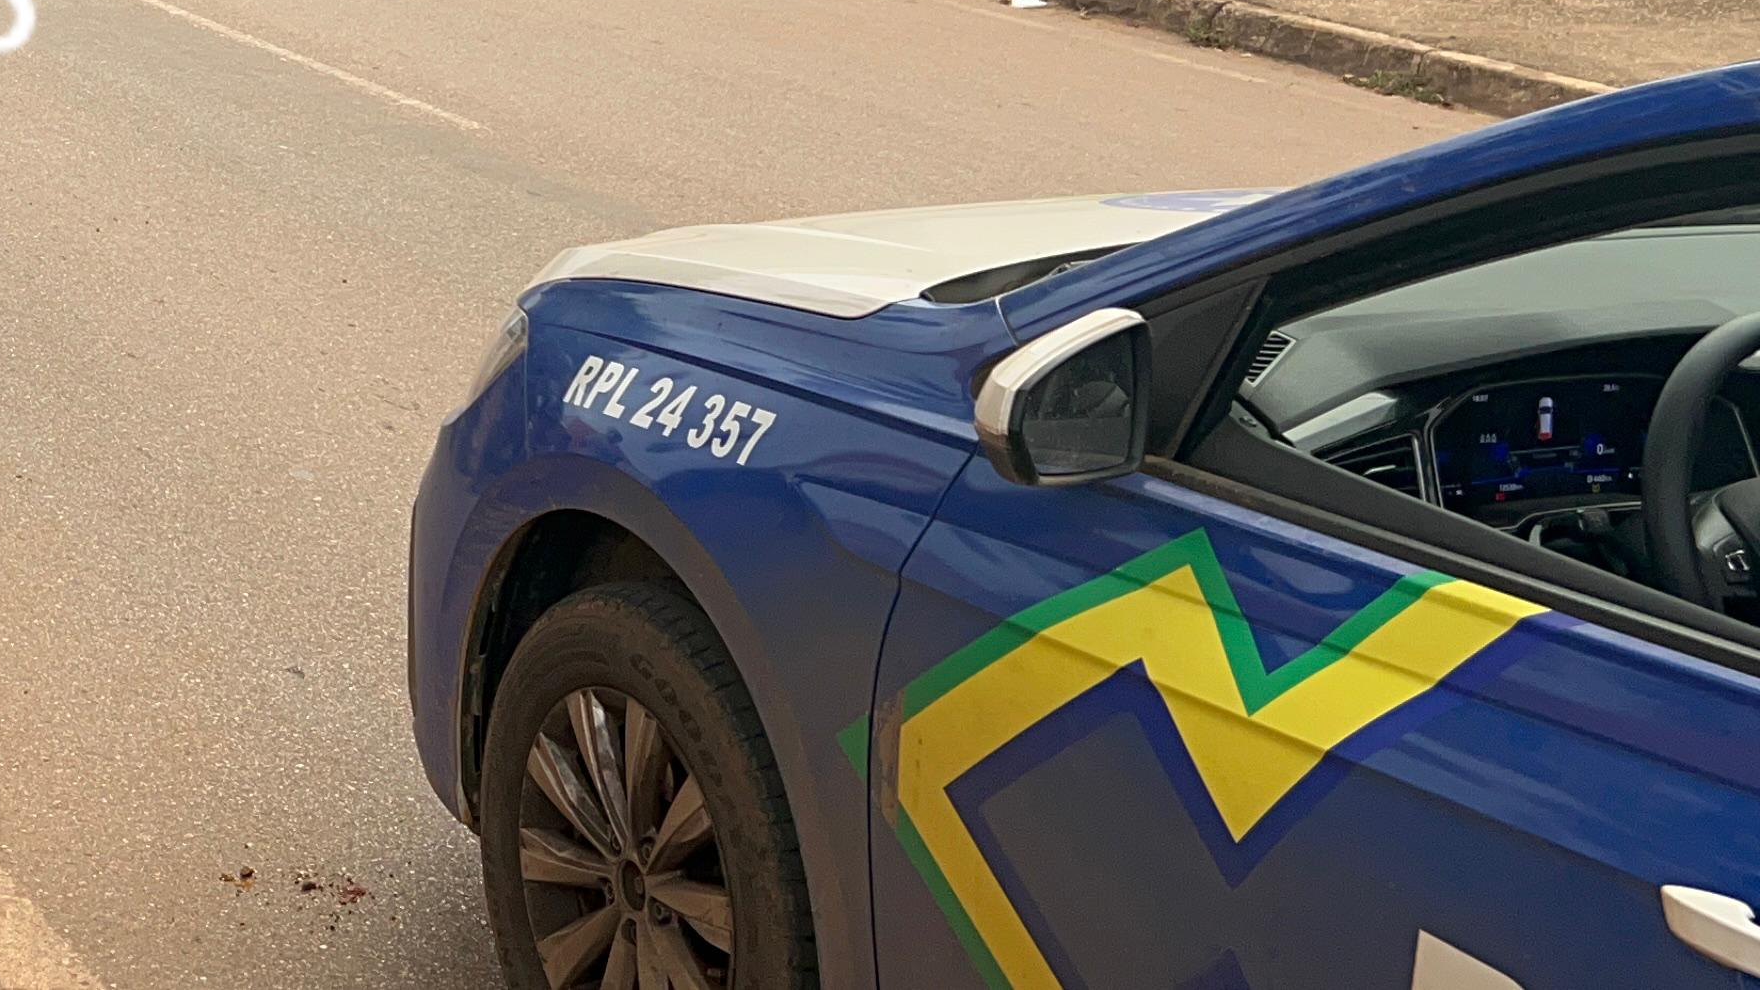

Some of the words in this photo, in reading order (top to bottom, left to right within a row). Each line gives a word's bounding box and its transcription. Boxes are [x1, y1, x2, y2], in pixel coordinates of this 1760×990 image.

[562, 355, 640, 420] RPL
[629, 377, 698, 438] 24
[687, 394, 778, 466] 357
